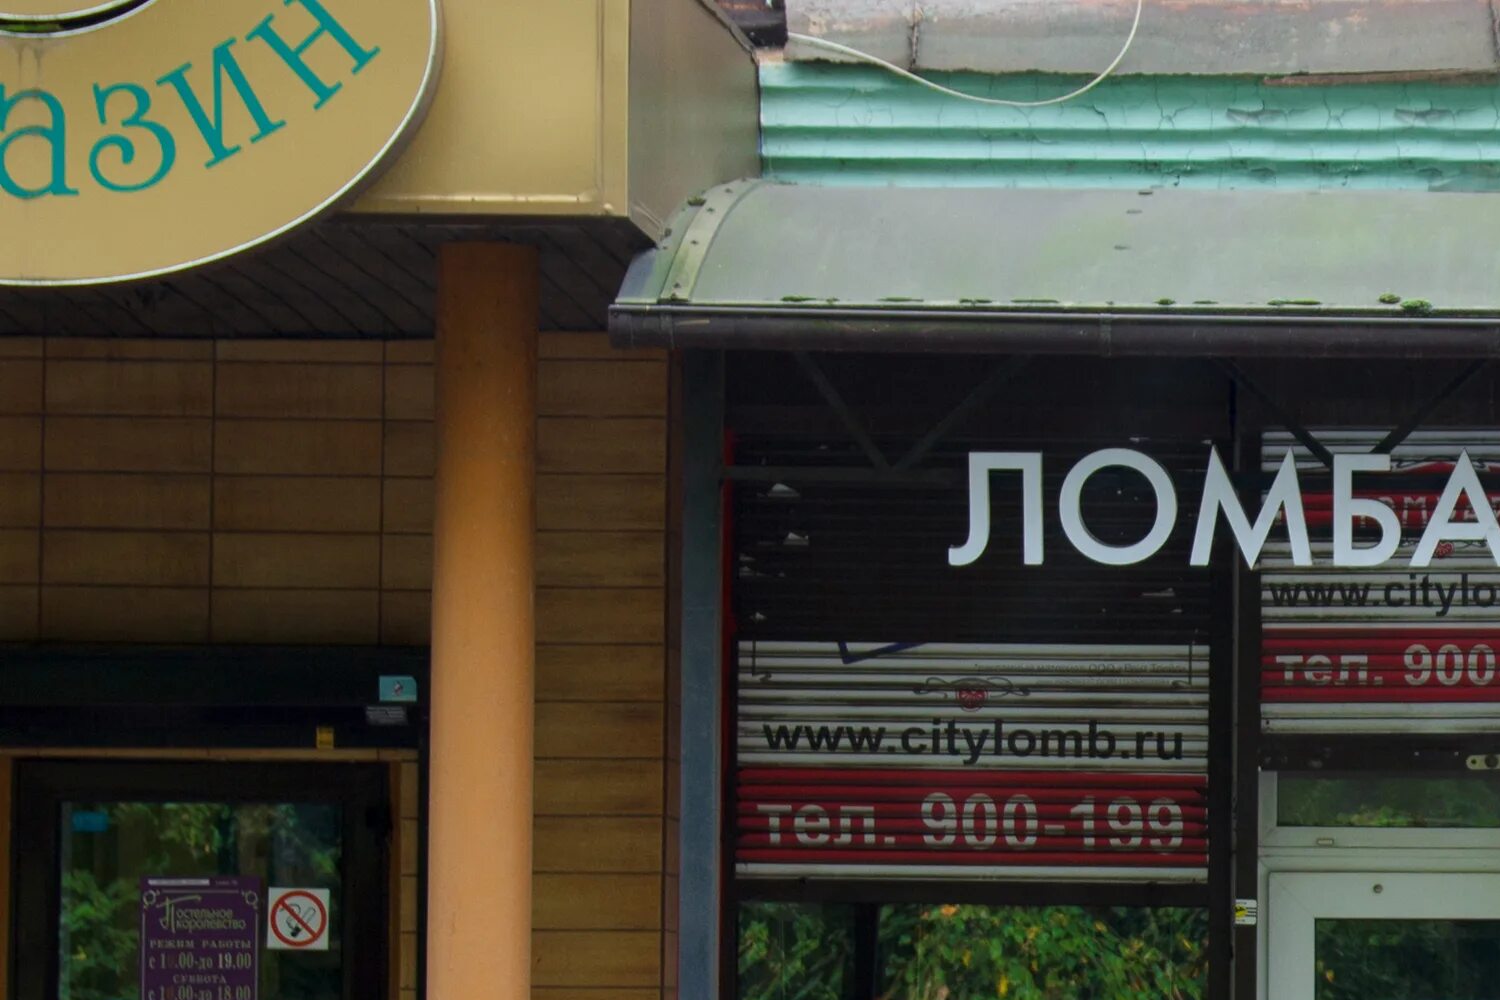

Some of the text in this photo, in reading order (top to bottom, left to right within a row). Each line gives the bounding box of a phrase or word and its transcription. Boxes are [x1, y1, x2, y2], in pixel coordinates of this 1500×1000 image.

[1275, 653, 1384, 687] тел.
[762, 717, 1184, 766] www.citylomb.ru
[757, 792, 1184, 856] тел. 900-199
[218, 952, 252, 970] 19.00
